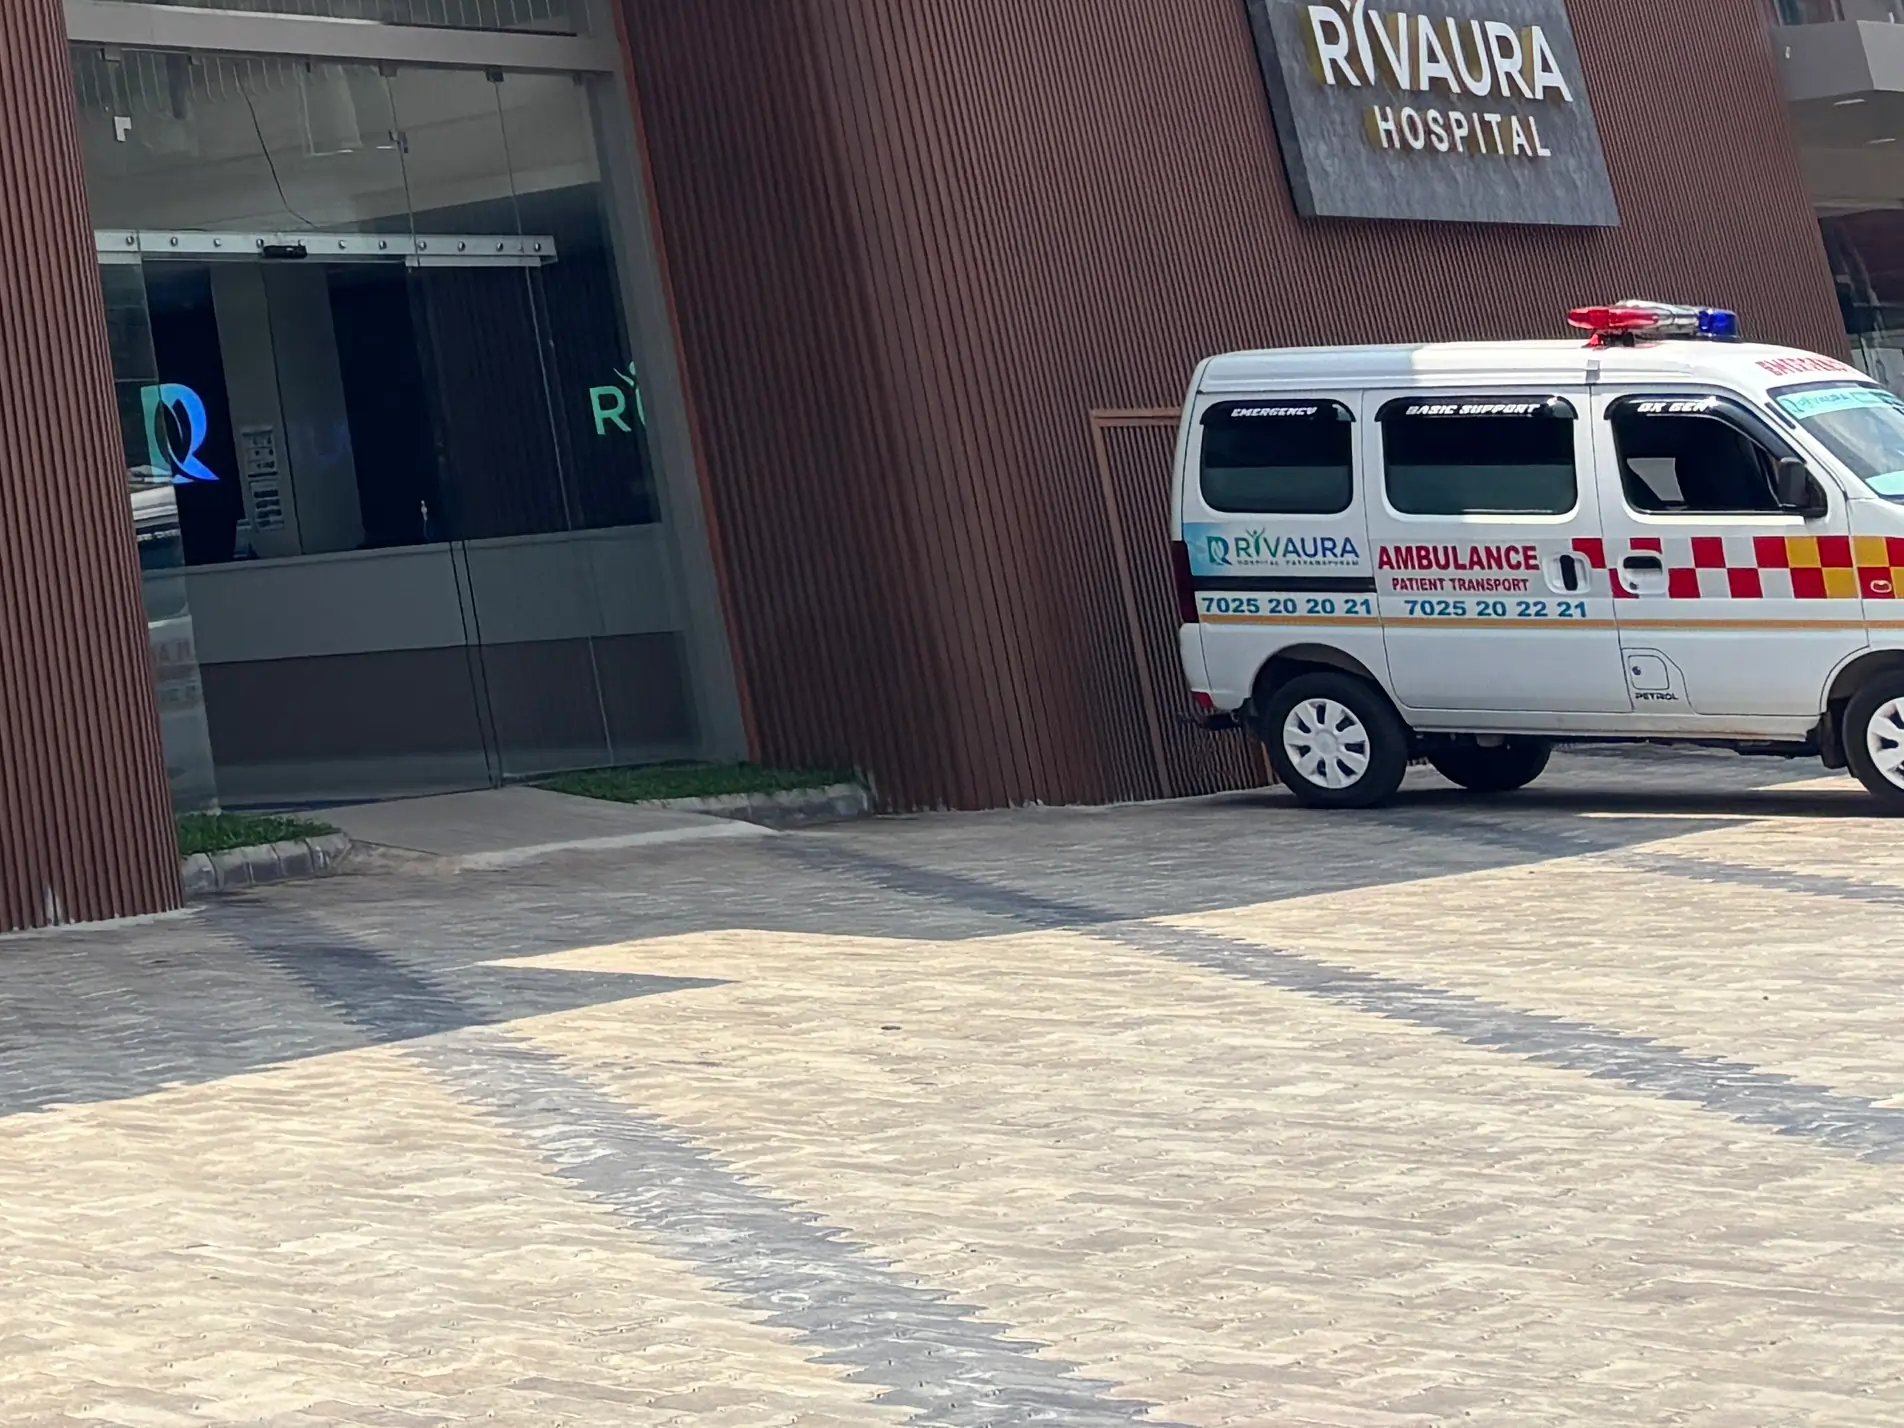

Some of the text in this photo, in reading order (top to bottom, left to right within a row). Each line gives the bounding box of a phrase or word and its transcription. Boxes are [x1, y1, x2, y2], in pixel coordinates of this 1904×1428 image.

[1373, 104, 1552, 157] HOSPITAL
[1231, 406, 1318, 417] EMERGENCY
[1406, 403, 1541, 416] BASIC SUPPORT
[1377, 545, 1541, 572] AMBULANCE
[1391, 577, 1530, 592] PATIENT TRANSPORT
[1201, 597, 1372, 615] 7025 20 20 21
[1404, 599, 1587, 618] 7025 20 22 21
